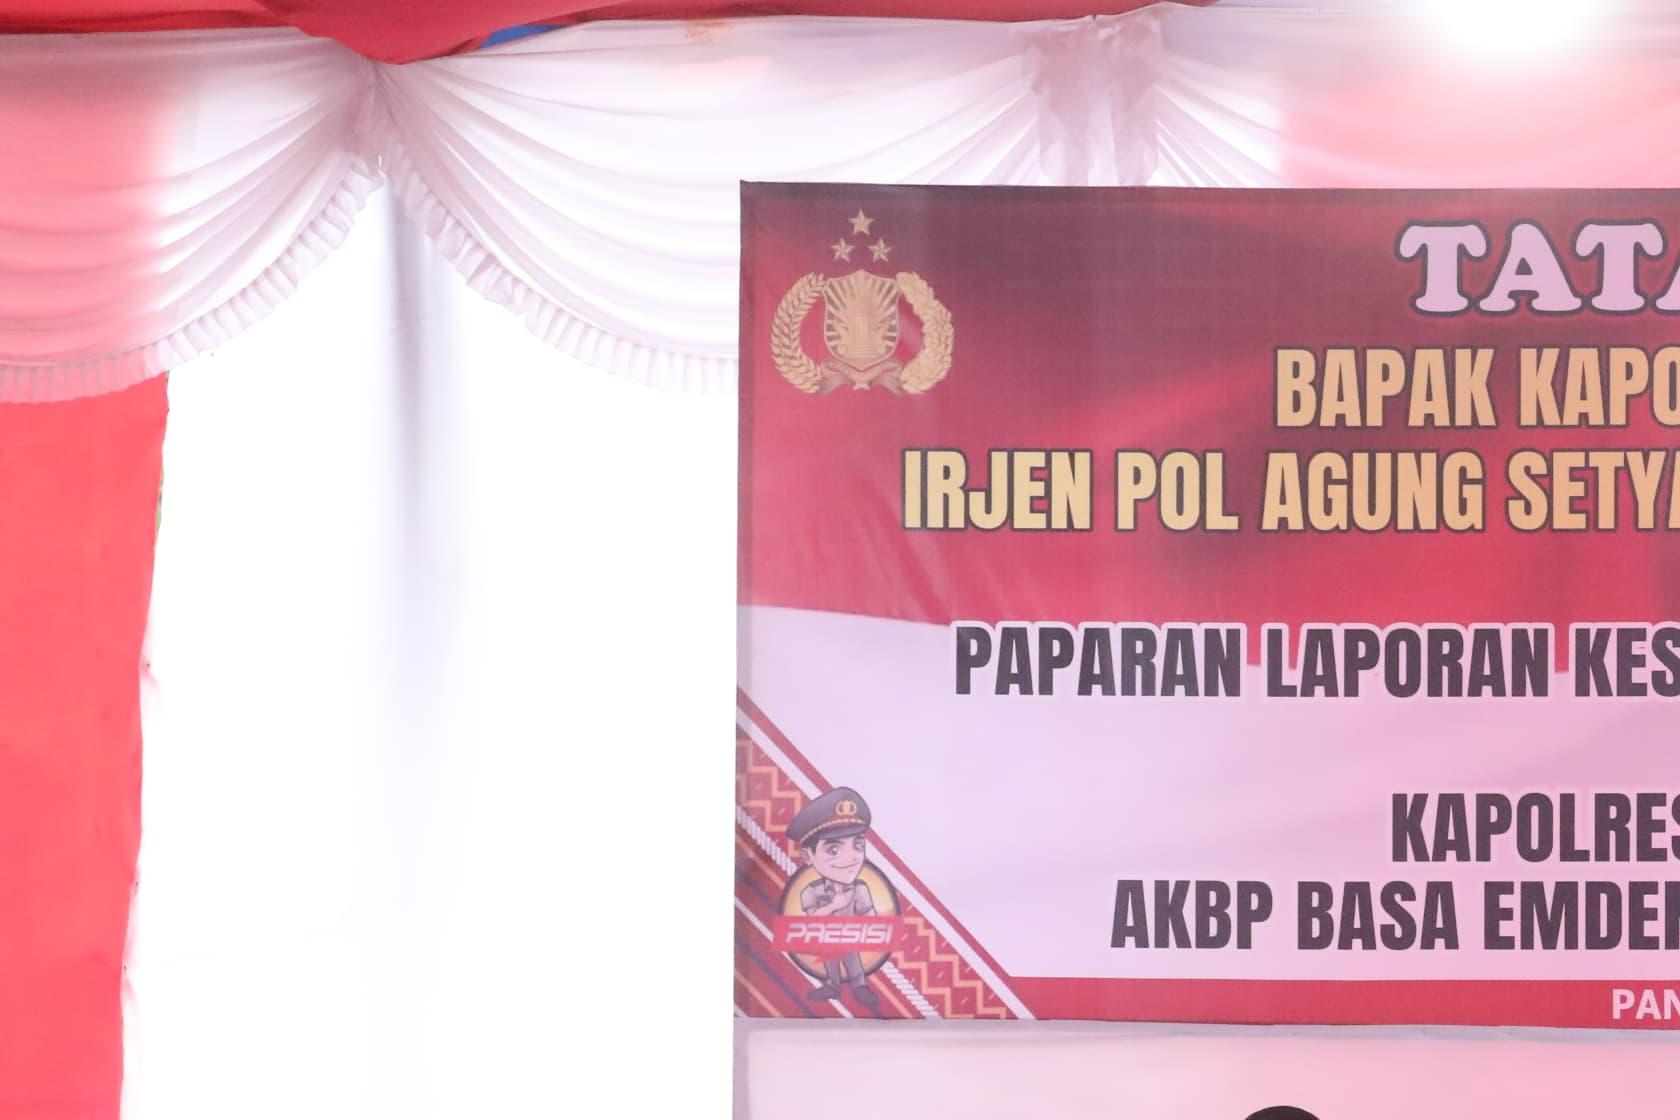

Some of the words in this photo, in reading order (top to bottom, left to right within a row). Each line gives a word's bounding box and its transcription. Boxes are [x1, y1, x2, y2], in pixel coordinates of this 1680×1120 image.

[1275, 347, 1497, 427] BAPAK
[903, 450, 1092, 530] IRJEN
[1116, 450, 1240, 530] POL
[1260, 450, 1485, 532] AGUNG
[954, 626, 1242, 697] PAPARAN
[1266, 626, 1550, 698] LAPORAN
[786, 923, 893, 944] PRESISI
[1109, 879, 1274, 950] AKBP
[1297, 880, 1460, 951] BASA
